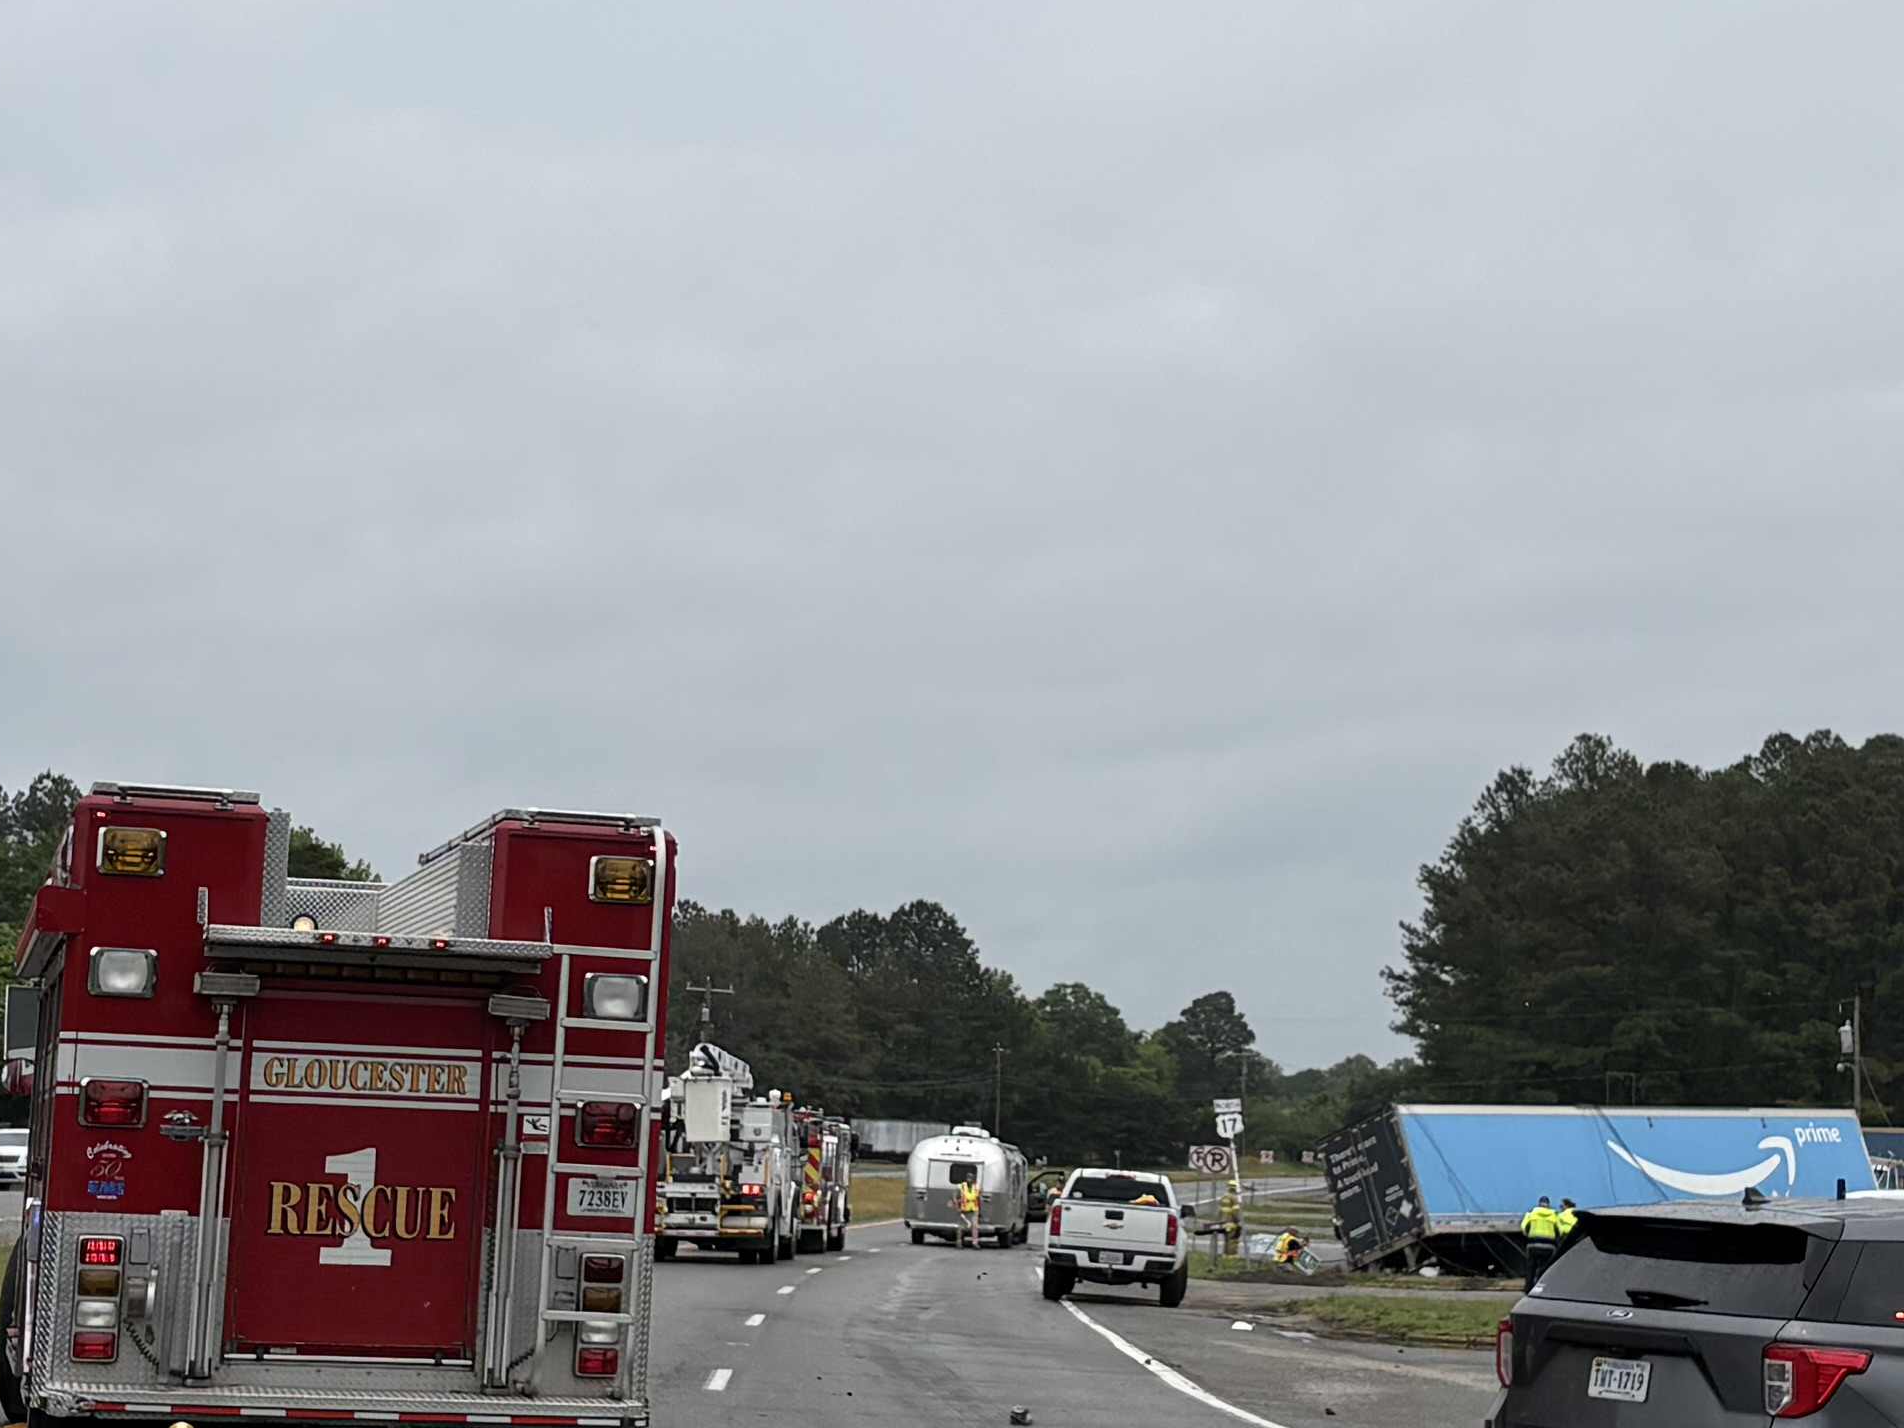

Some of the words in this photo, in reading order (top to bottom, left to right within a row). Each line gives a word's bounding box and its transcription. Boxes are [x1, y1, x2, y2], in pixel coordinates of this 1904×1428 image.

[263, 1057, 469, 1095] GLOUCESTER
[1222, 1118, 1237, 1133] 17
[1794, 1122, 1842, 1148] prime
[266, 1181, 456, 1240] RESCUE
[319, 1147, 392, 1266] 1
